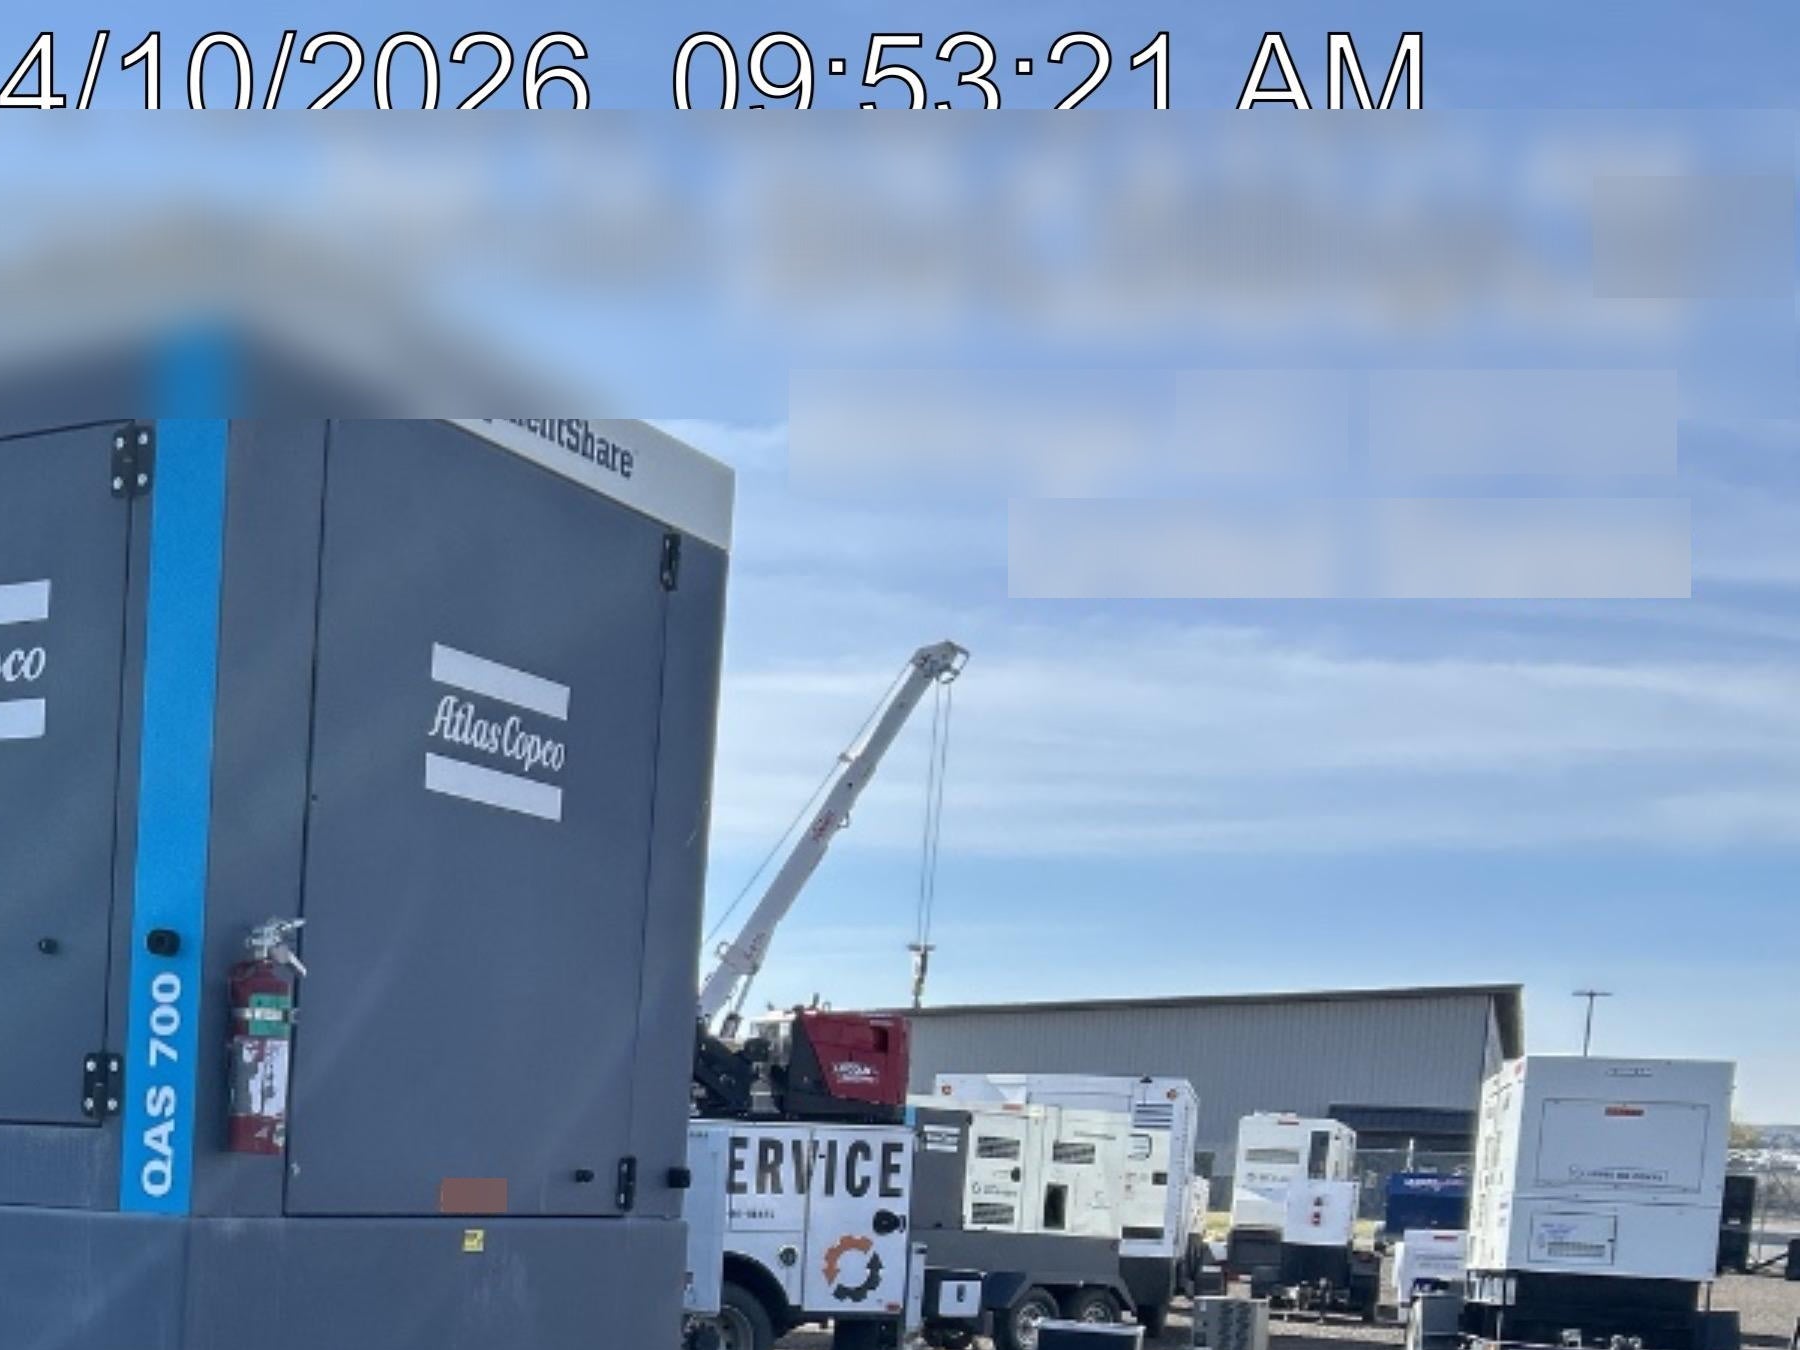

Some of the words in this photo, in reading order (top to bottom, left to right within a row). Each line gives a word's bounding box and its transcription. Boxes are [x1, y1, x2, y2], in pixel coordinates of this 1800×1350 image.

[428, 695, 502, 753] Atlas
[503, 714, 566, 772] Copco
[149, 971, 182, 1067] 700
[141, 1085, 177, 1197] QAS
[726, 1136, 904, 1198] ERVICE
